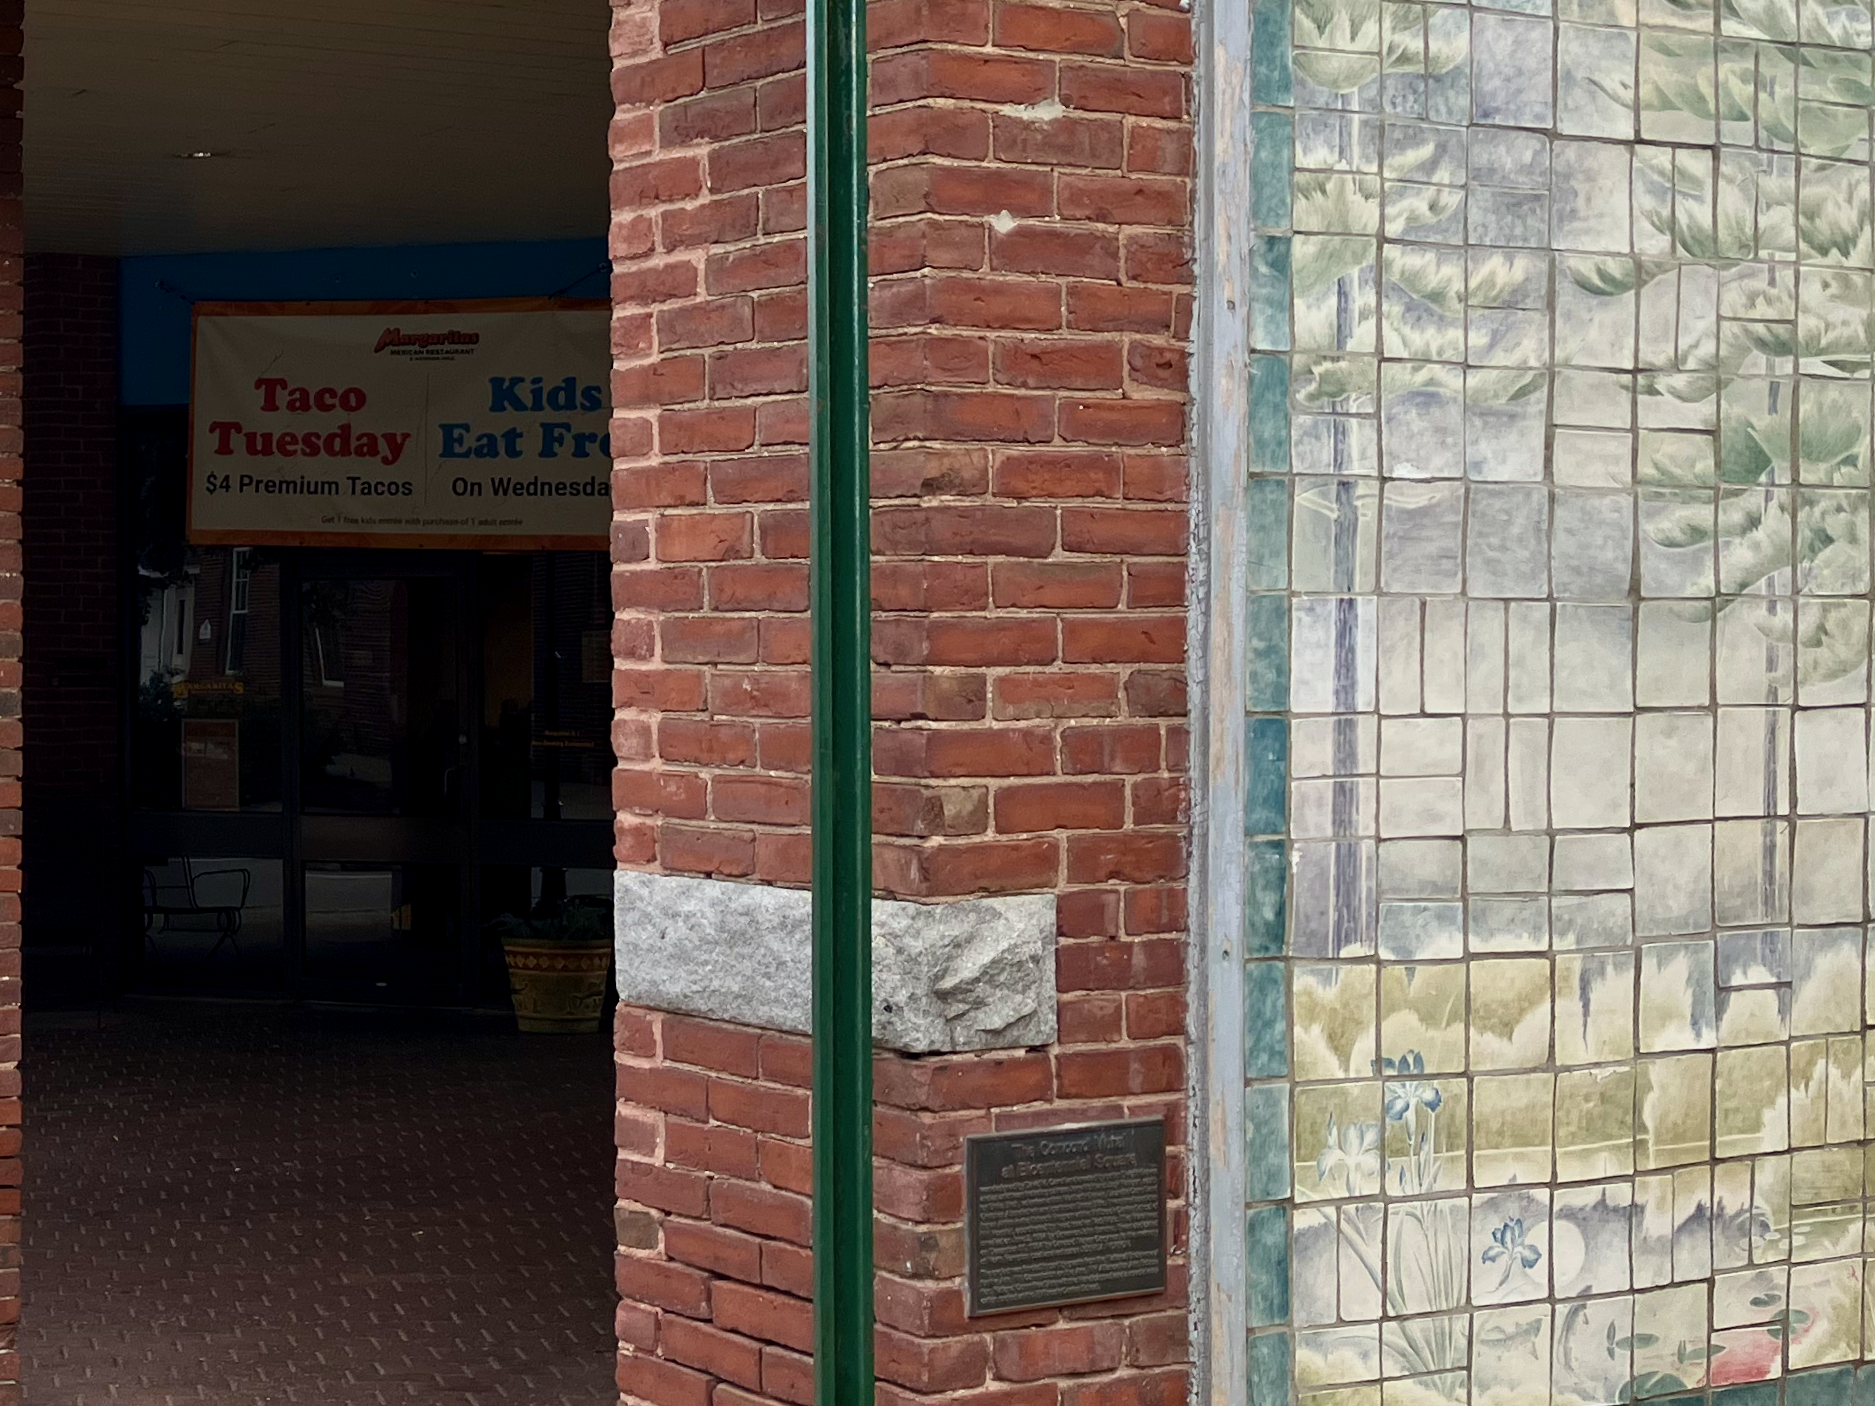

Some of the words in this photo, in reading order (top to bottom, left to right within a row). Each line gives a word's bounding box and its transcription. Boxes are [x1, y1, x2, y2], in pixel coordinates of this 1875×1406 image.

[254, 376, 368, 414] Taco
[488, 375, 603, 414] Kids
[208, 420, 412, 466] Tuesday
[438, 423, 524, 461] Eat
[205, 472, 232, 496] $4
[238, 474, 340, 496] Premium
[346, 476, 414, 498] Tacos
[451, 476, 488, 497] On
